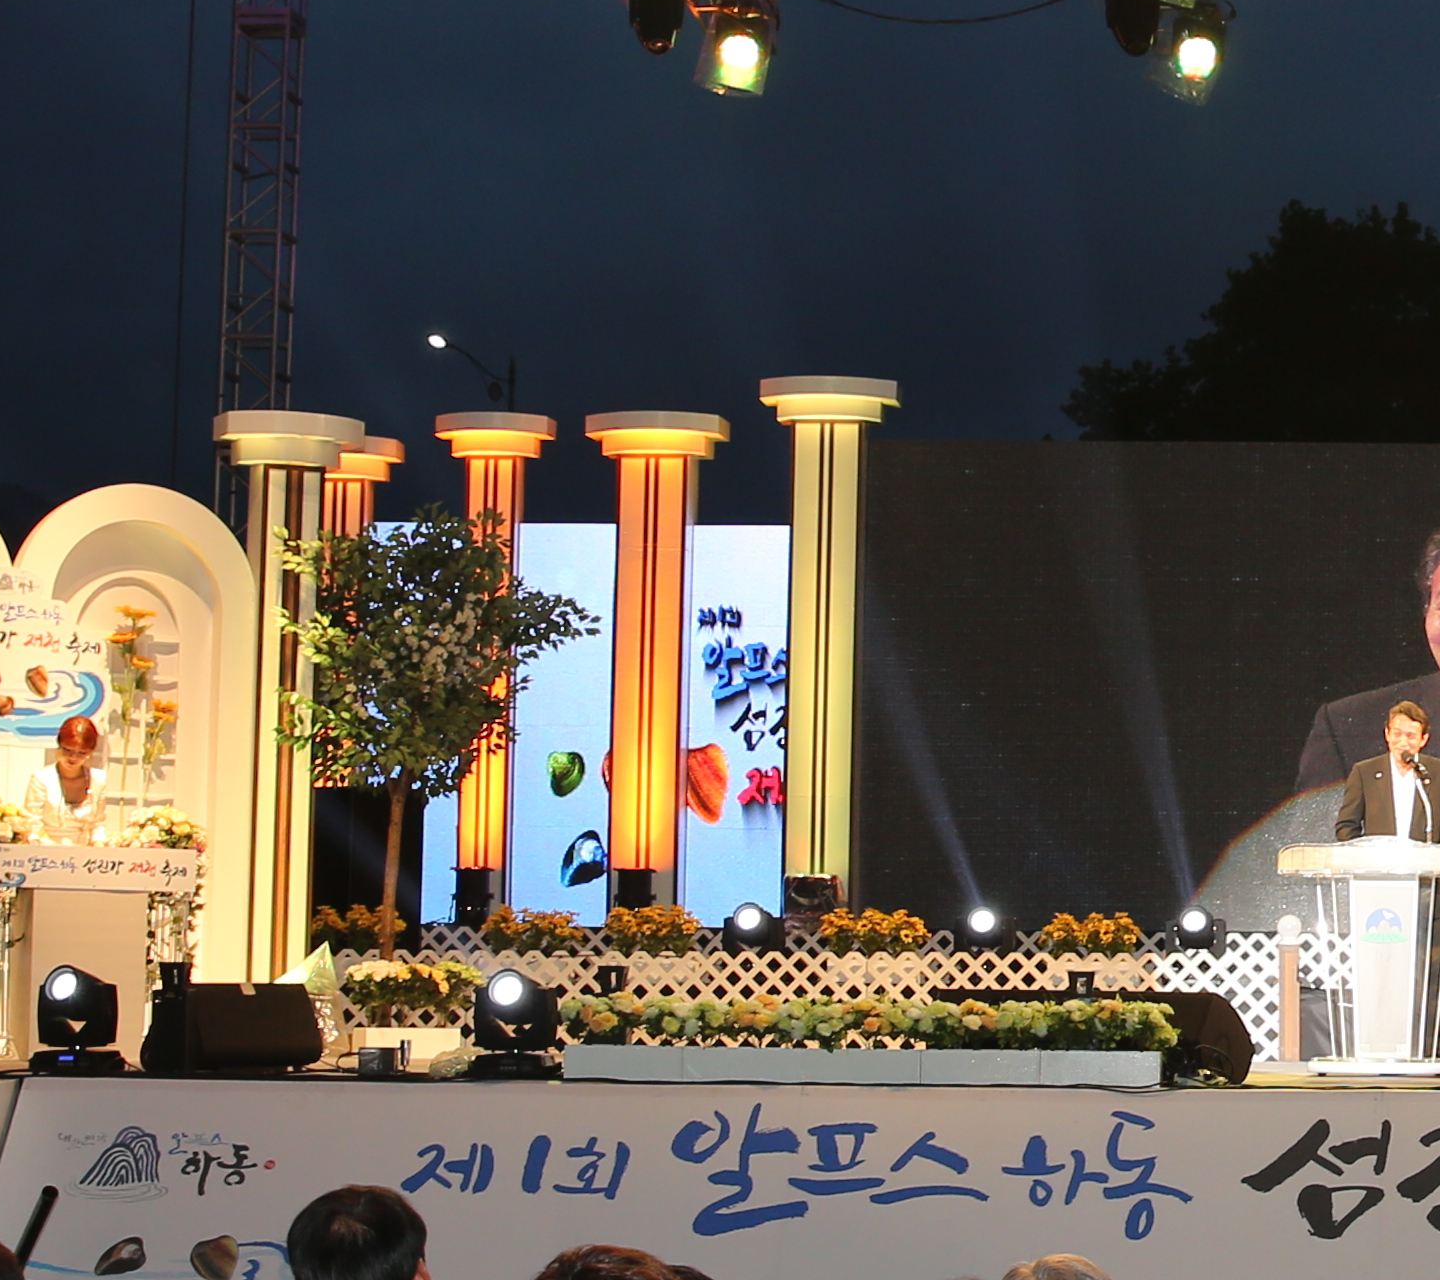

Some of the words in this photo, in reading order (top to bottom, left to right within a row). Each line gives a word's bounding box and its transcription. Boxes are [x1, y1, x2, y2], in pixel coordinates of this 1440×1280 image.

[66, 632, 101, 666] 축제
[180, 1143, 258, 1197] 하동
[401, 1134, 630, 1195] 제1회
[671, 1103, 990, 1237] 알프스
[1002, 1111, 1194, 1240] 하동
